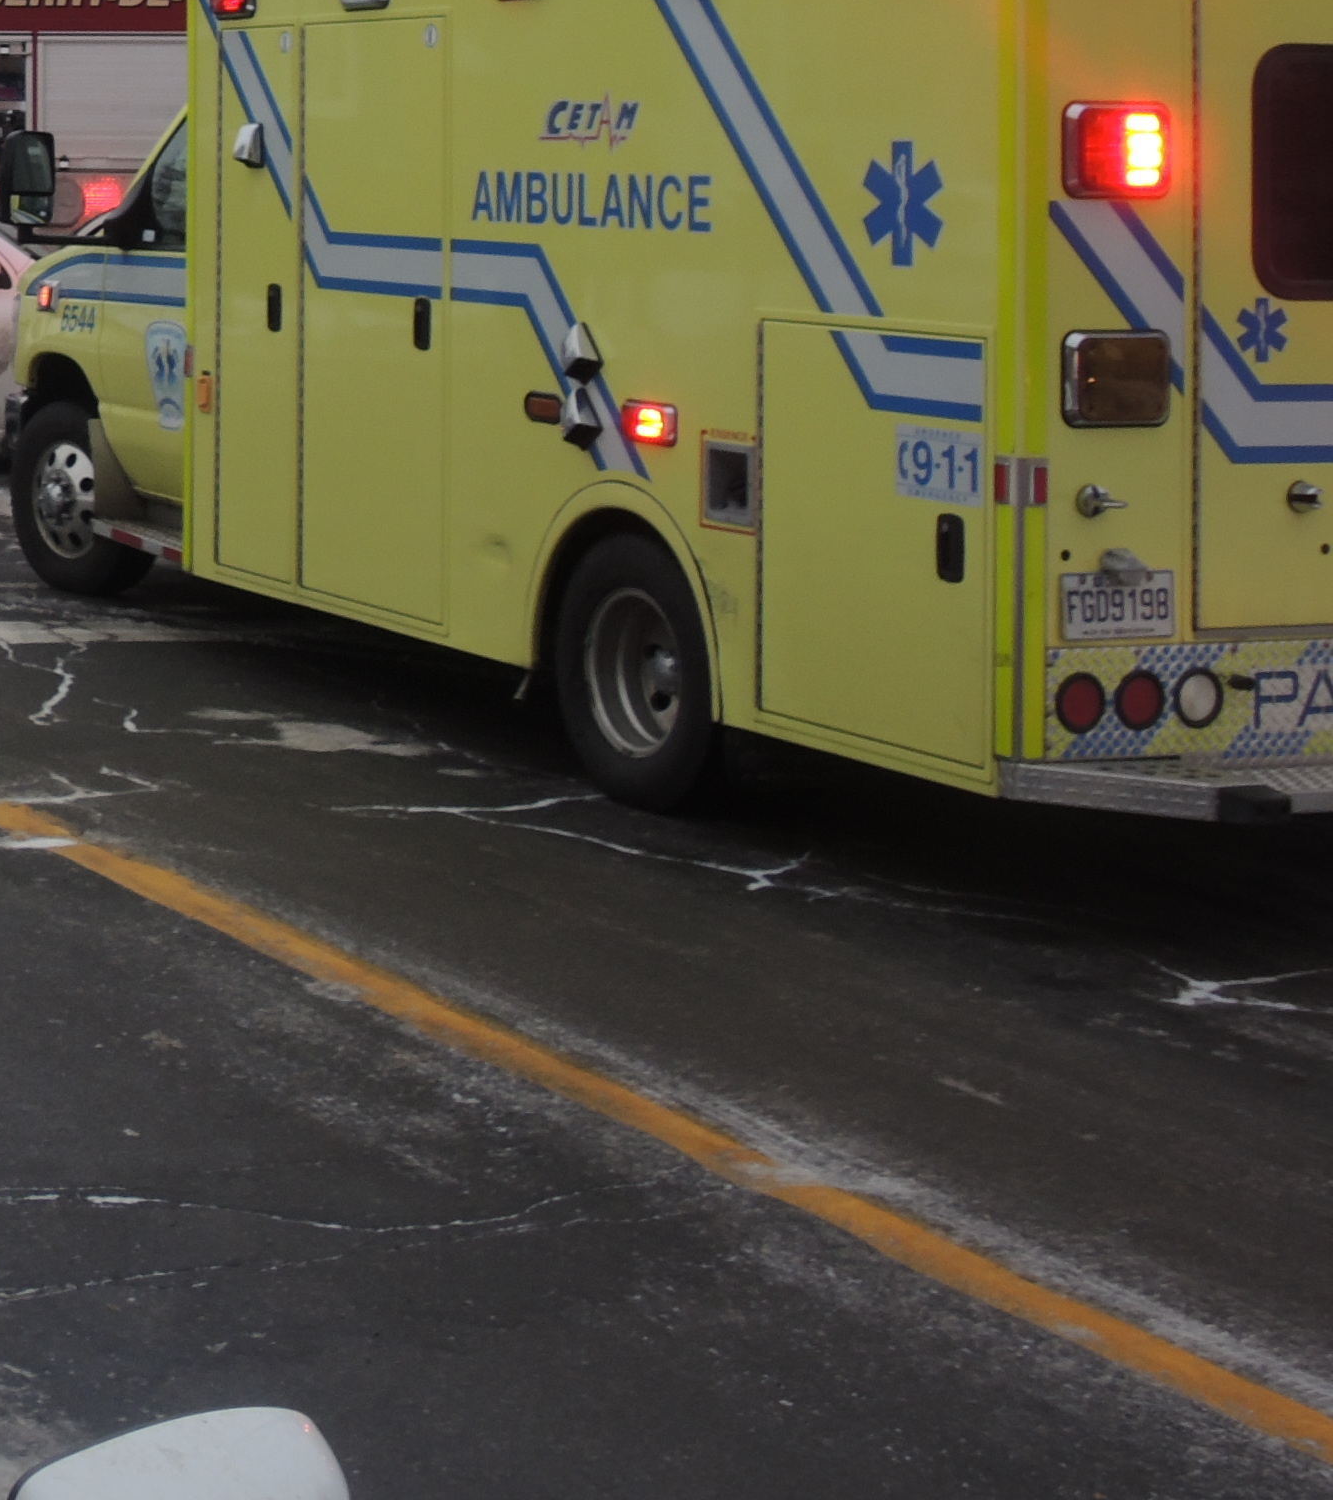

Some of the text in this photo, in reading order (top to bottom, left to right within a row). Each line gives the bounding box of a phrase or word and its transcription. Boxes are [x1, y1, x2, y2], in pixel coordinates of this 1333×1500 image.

[539, 90, 638, 151] CETAM
[472, 169, 712, 232] AMBULANCE
[60, 304, 96, 334] 6544
